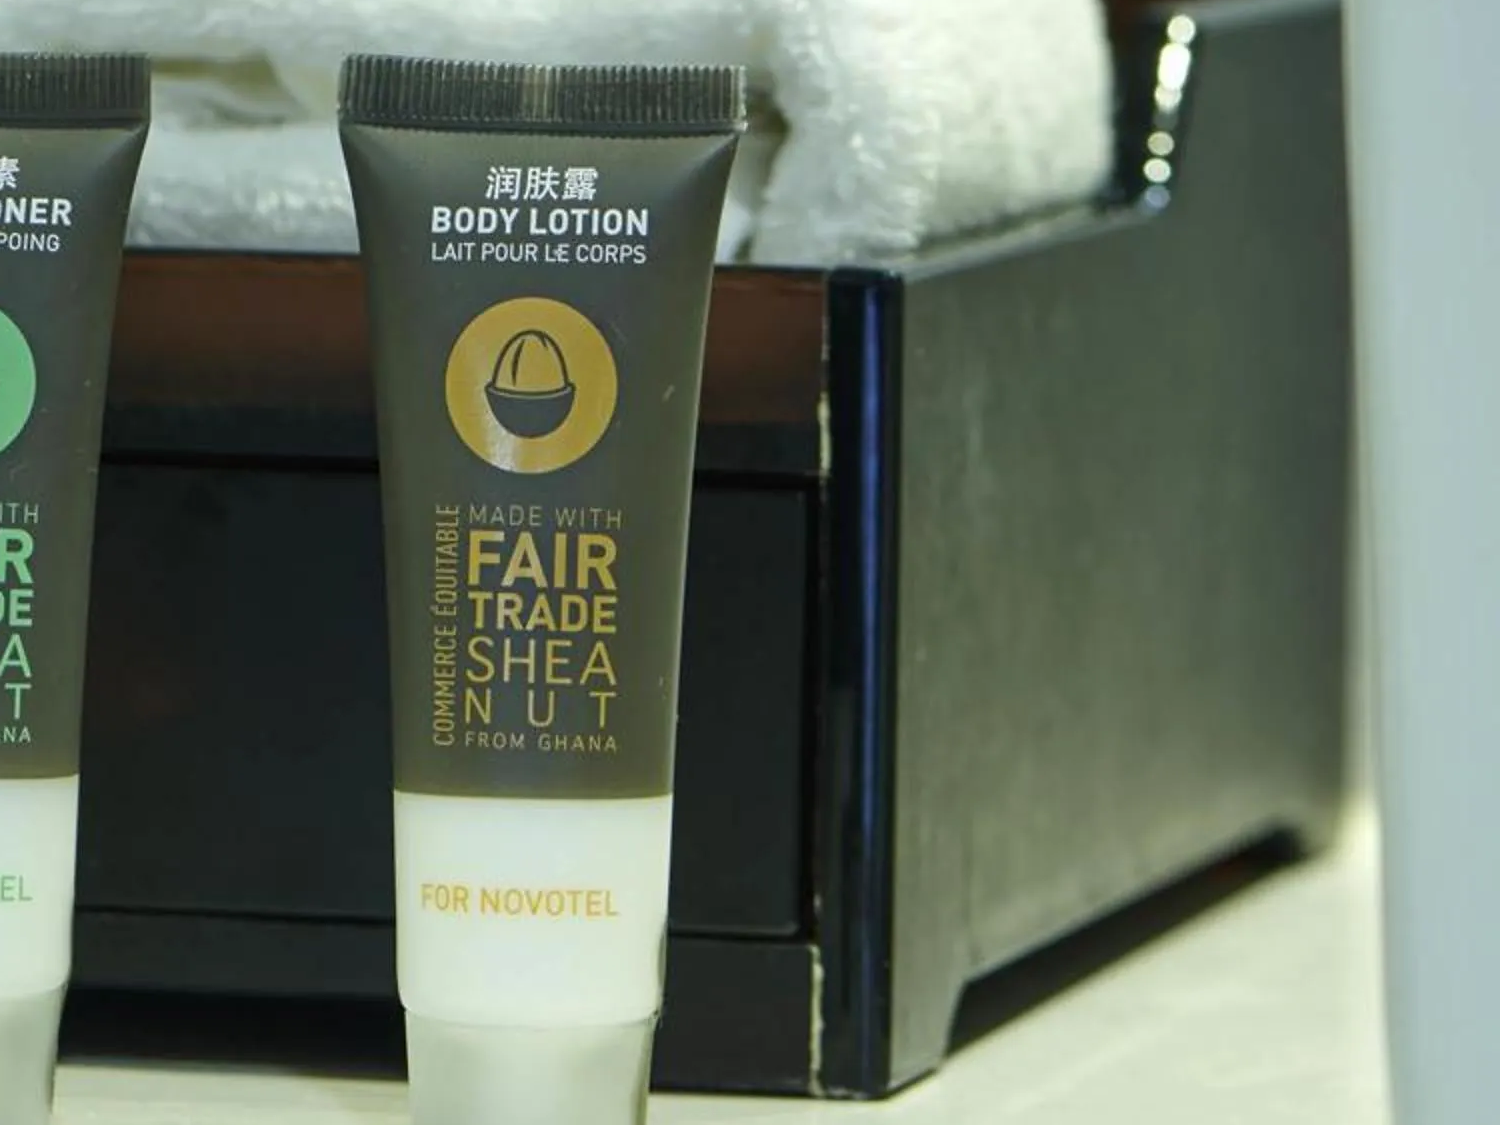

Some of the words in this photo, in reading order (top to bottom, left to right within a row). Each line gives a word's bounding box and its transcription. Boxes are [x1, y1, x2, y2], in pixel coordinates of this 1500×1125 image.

[485, 166, 599, 201] 润肤露
[431, 206, 520, 235] BODY
[529, 208, 649, 237] LOTION
[431, 242, 477, 262] LAIT
[481, 243, 538, 262] POUR
[545, 244, 569, 263] LE
[576, 244, 648, 265] CORPS
[469, 504, 543, 526] MADE
[555, 508, 623, 530] WITH
[430, 503, 461, 616] ÉQUITABLE
[467, 530, 618, 590] FAIR
[467, 591, 618, 634] TRADE
[465, 636, 617, 686] SHEA
[432, 624, 457, 747] COMMERCE
[464, 687, 617, 728] NUT
[465, 731, 525, 749] FROM
[538, 733, 618, 752] GHANA
[420, 883, 469, 913] FOR
[480, 887, 619, 917] NOVOTEL
